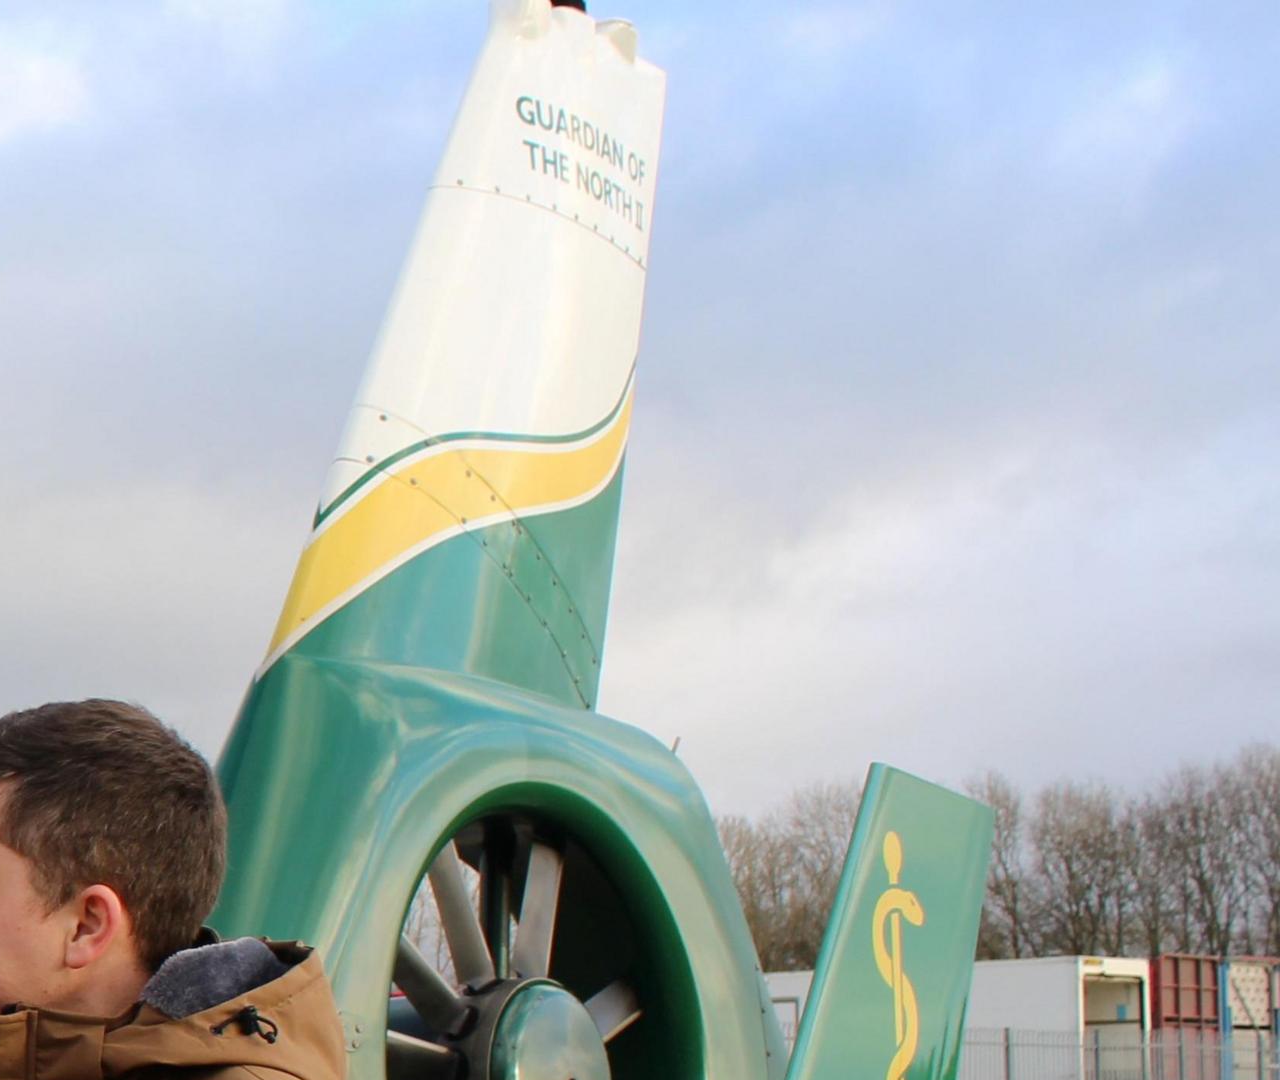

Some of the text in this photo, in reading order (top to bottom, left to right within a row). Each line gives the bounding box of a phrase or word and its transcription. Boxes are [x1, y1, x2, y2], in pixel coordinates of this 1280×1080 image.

[516, 95, 646, 187] GUARDIAN OF
[522, 139, 570, 184] THE
[576, 161, 633, 223] NORTH
